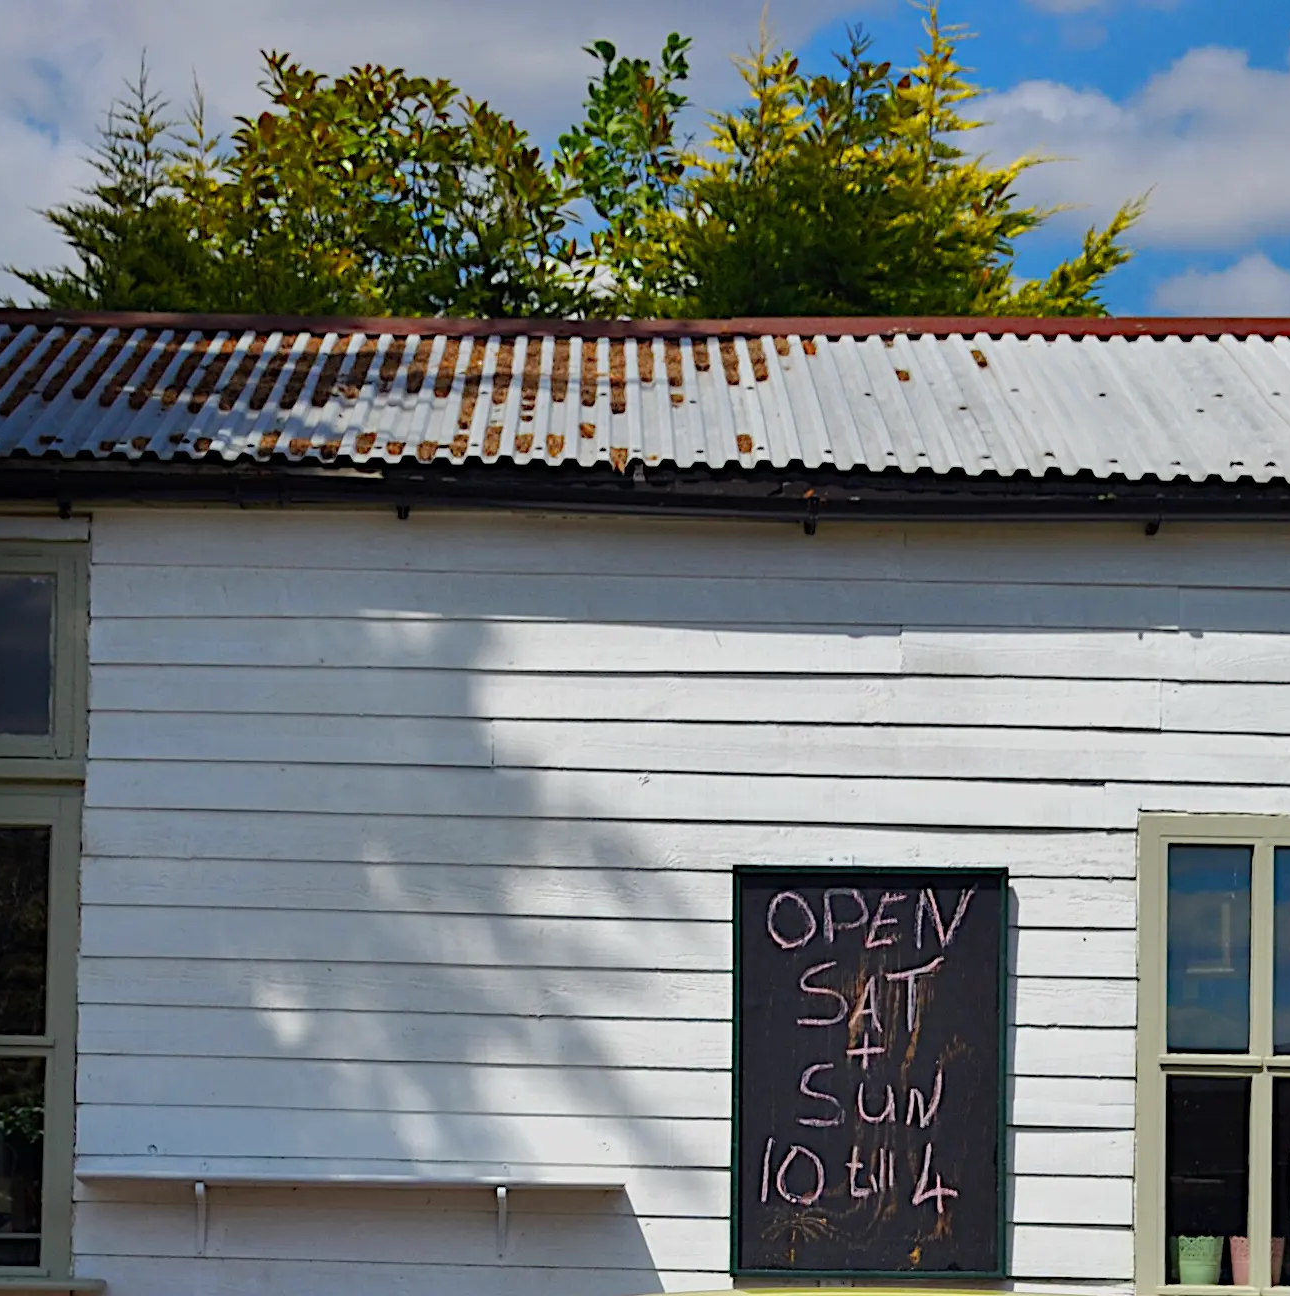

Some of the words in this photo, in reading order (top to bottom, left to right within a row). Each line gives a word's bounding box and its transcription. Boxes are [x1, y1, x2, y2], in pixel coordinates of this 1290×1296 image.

[766, 883, 977, 949] OPEN
[797, 957, 944, 1032] SAT
[846, 1032, 885, 1068] +
[797, 1062, 943, 1129] SUN
[761, 1137, 825, 1206] 10
[846, 1145, 893, 1198] till
[912, 1142, 958, 1214] 4
